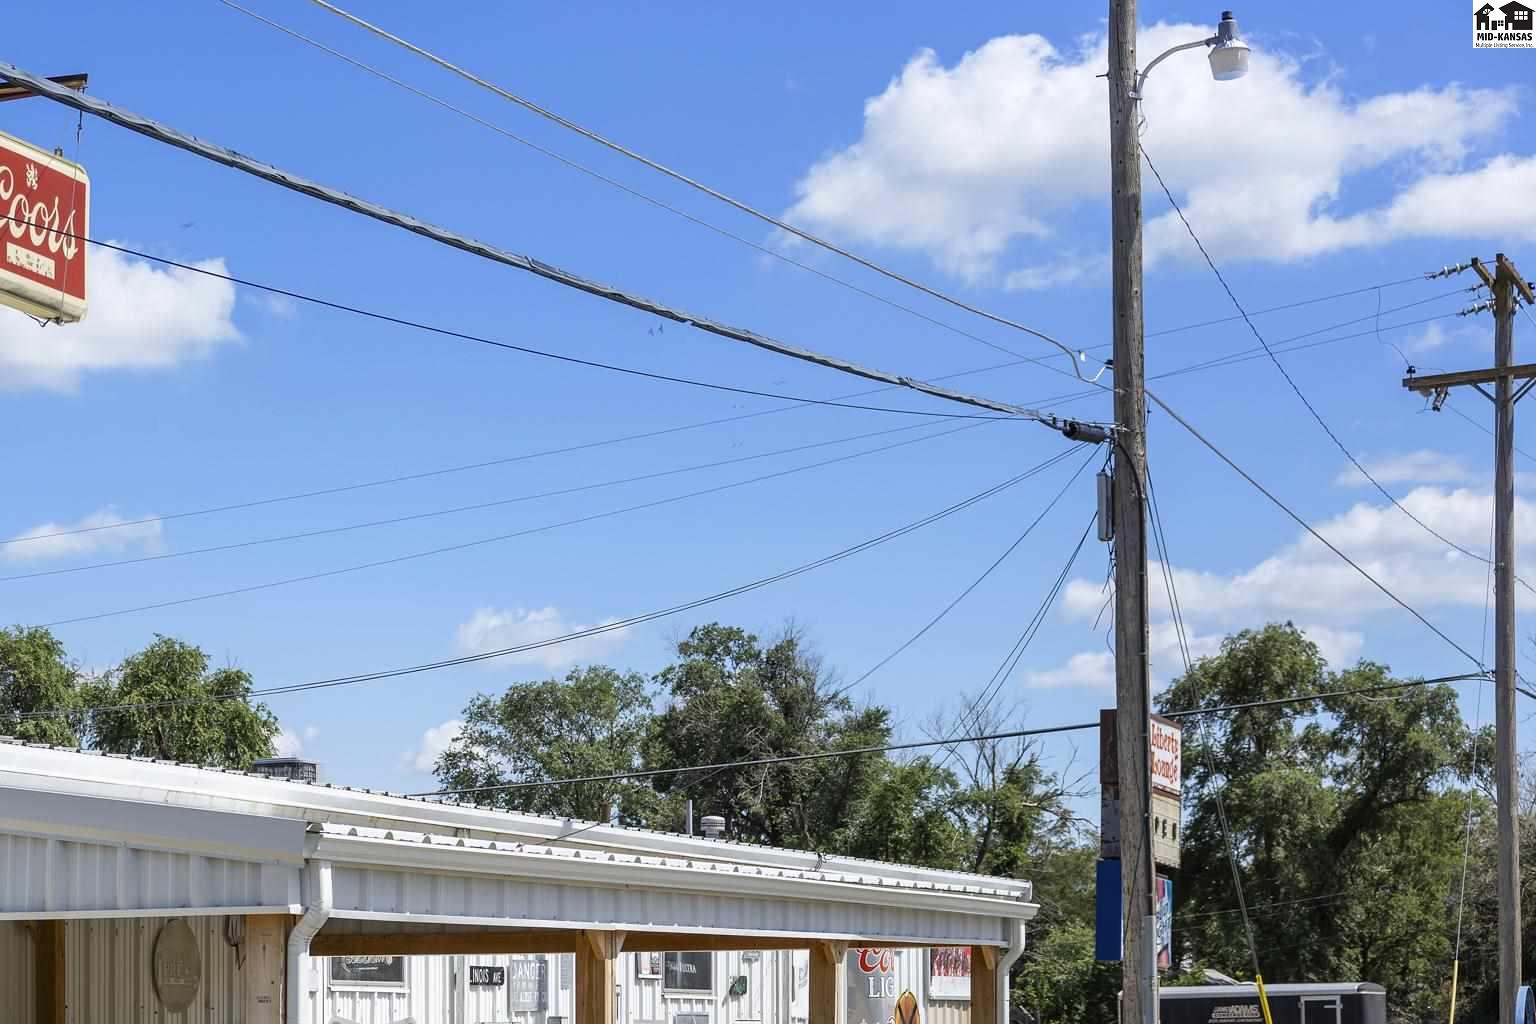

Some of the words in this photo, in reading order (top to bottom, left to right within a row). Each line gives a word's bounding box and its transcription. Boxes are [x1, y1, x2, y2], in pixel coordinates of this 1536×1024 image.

[1151, 723, 1178, 760] Liberty
[1151, 752, 1178, 785] Lounge
[868, 976, 895, 998] LIG
